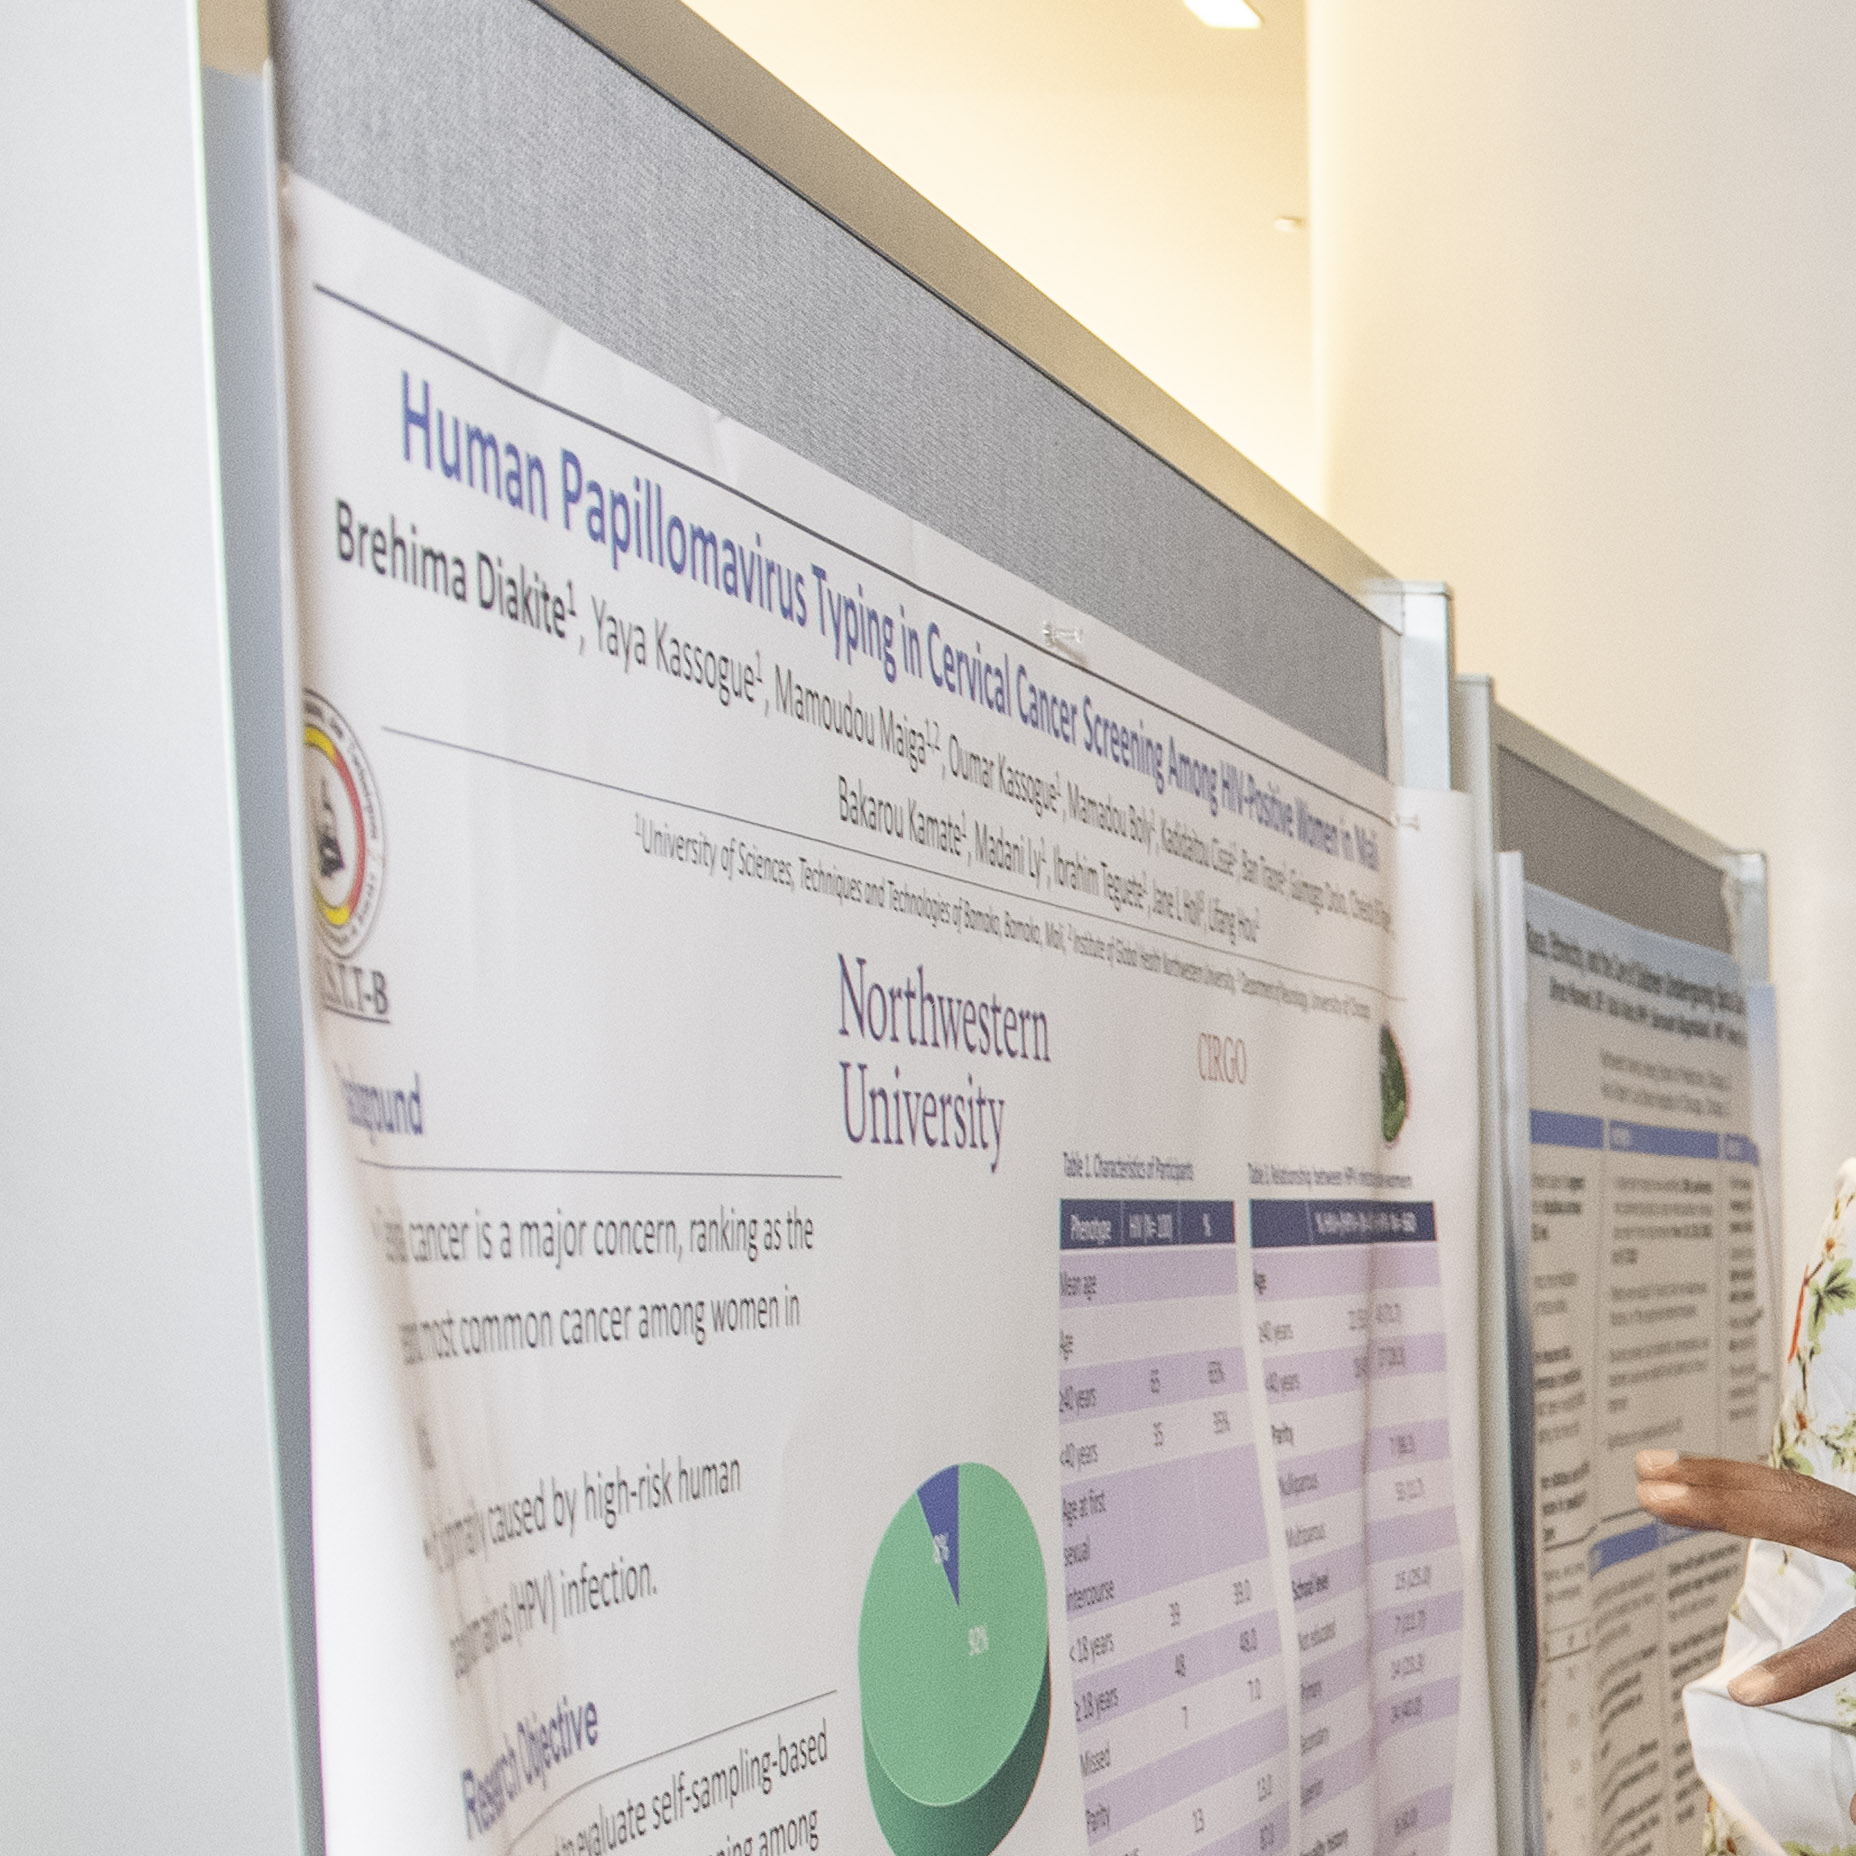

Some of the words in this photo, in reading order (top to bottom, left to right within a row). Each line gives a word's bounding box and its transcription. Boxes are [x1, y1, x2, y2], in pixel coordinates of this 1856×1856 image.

[400, 369, 548, 521] Human
[560, 448, 808, 630] Papillomavirus
[812, 564, 897, 685] Typing
[901, 608, 922, 679] in
[927, 623, 1011, 716] Cervical
[1016, 664, 1076, 746] Cancer
[1083, 694, 1164, 795] Screening
[1168, 736, 1219, 817] Among
[335, 498, 468, 601] Brehima
[590, 594, 648, 676] Yaya
[775, 664, 876, 746] Mamoudou
[948, 733, 996, 790] Oumar
[1067, 781, 1128, 838] Mamadou
[838, 775, 904, 838] Bakarou
[975, 821, 1025, 874] Madani
[720, 838, 735, 881] of
[738, 842, 795, 893] Sciences,
[799, 857, 862, 906] Techniques
[864, 877, 886, 909] and
[887, 880, 951, 928] Technologies
[838, 952, 1051, 1063] Northwestern
[1198, 1030, 1247, 1085] CIRGO
[840, 1040, 1006, 1173] University
[408, 1221, 470, 1264] cancer
[475, 1208, 493, 1262] is
[499, 1220, 511, 1259] a
[519, 1207, 588, 1270] major
[592, 1218, 684, 1263] concern,
[688, 1204, 759, 1262] ranking
[762, 1216, 783, 1252] as
[786, 1205, 815, 1252] the
[461, 1311, 554, 1357] common
[559, 1304, 631, 1346] cancer
[638, 1299, 706, 1346] among
[710, 1291, 780, 1333] women
[784, 1284, 801, 1327] in
[488, 1478, 546, 1545] caused
[552, 1475, 577, 1538] by
[583, 1455, 673, 1530] high-risk
[677, 1455, 741, 1502] human
[560, 1555, 658, 1619] infection.
[517, 1695, 598, 1790] Objective
[652, 1717, 830, 1831] self-sampling-based
